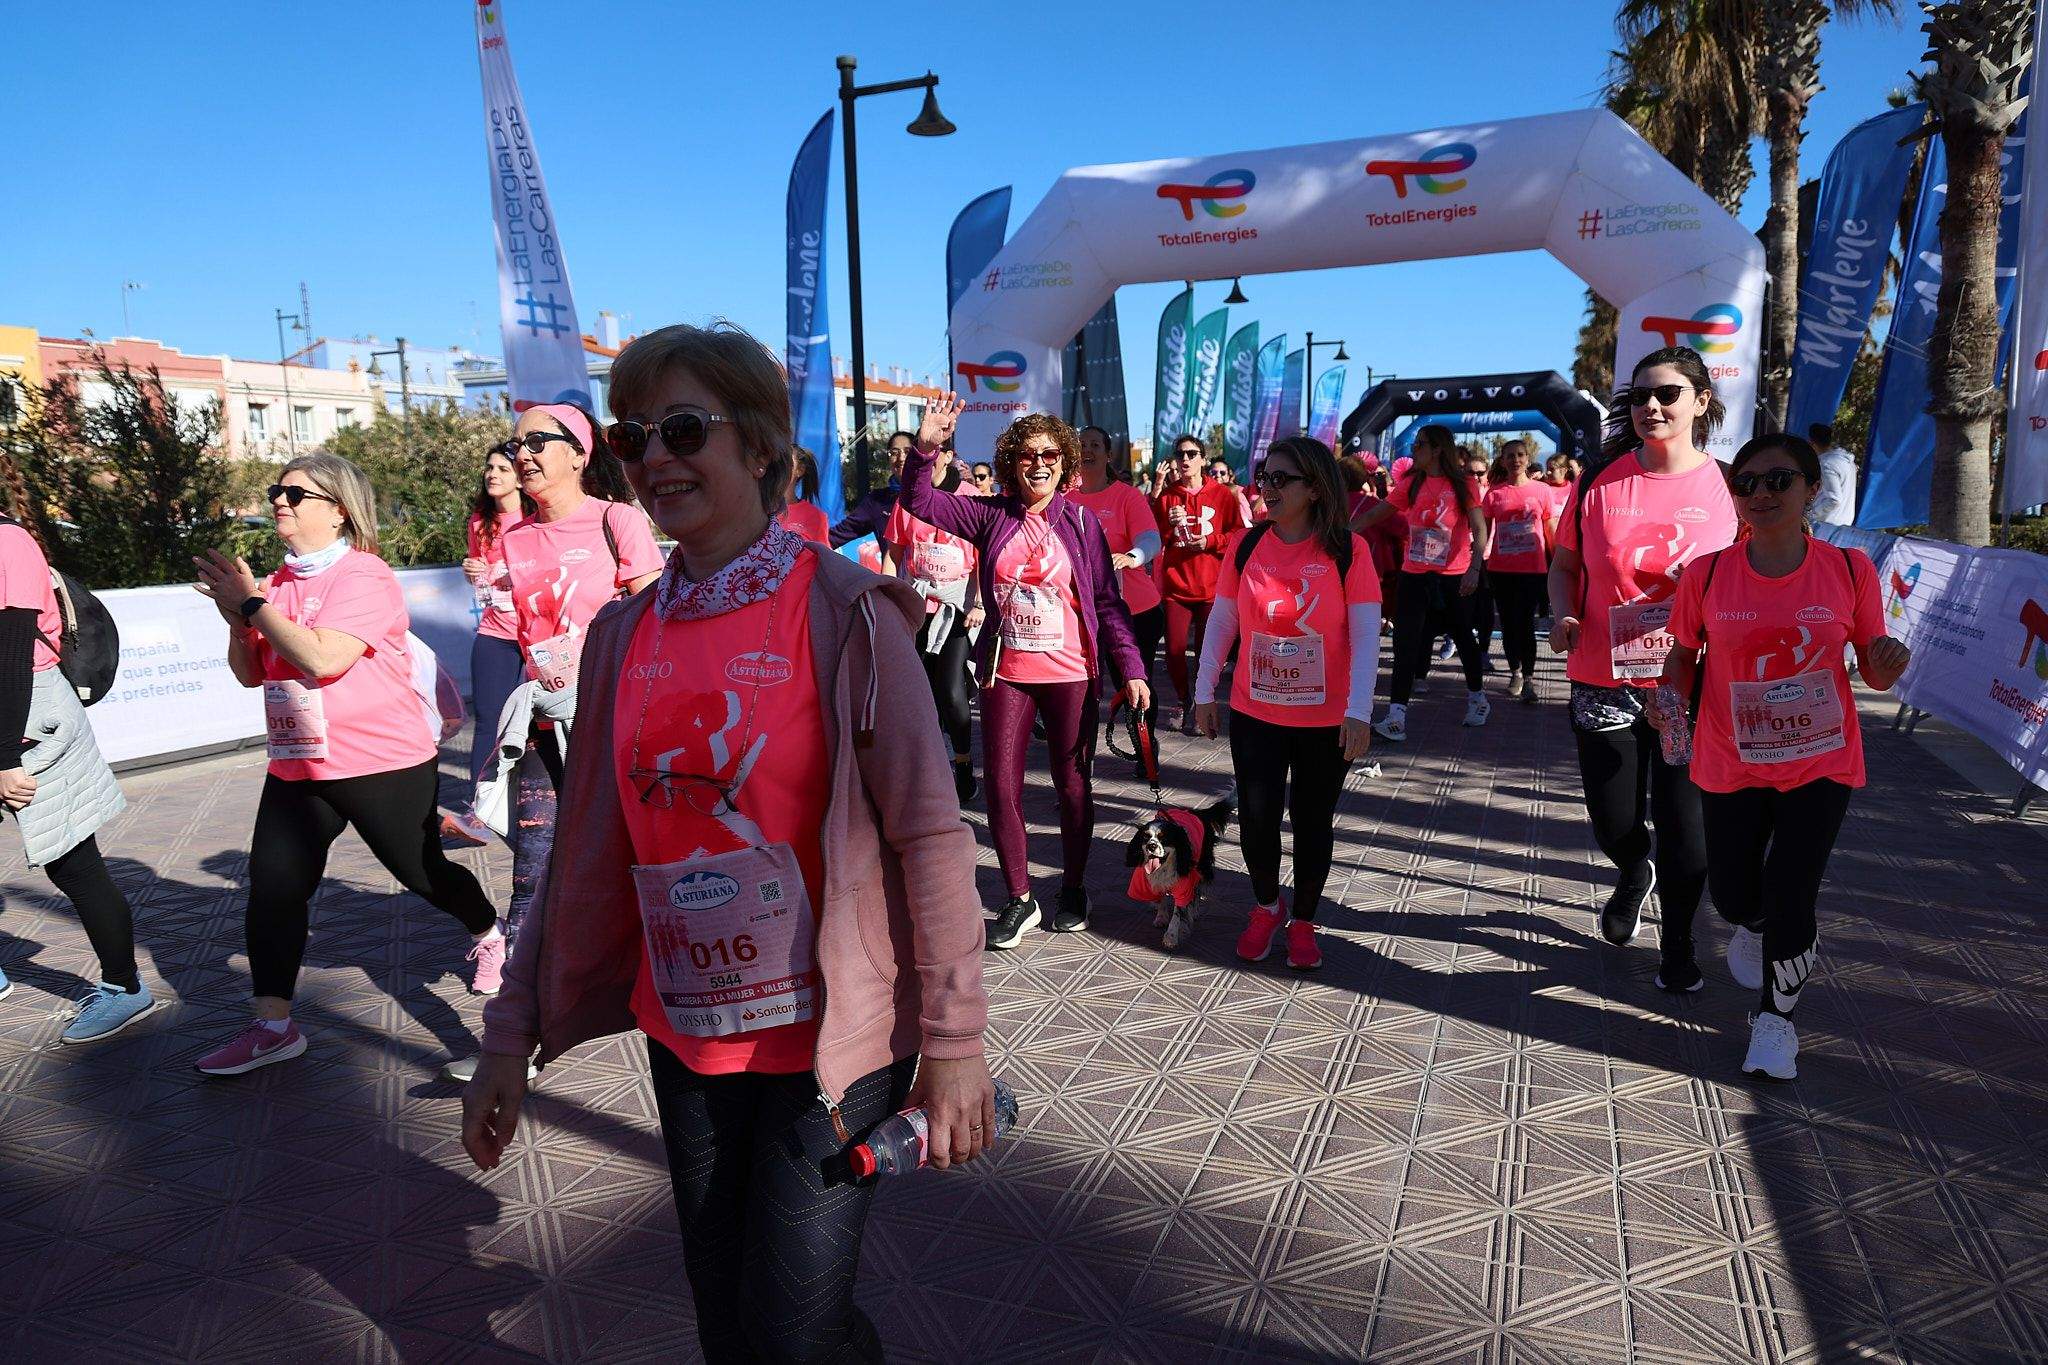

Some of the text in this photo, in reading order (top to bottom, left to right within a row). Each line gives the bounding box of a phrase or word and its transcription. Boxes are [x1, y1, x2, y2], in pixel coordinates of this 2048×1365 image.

[504, 106, 562, 286] LasCarreras
[1366, 204, 1477, 227] TotalEnergies
[1158, 227, 1258, 247] TotalEnergies
[1799, 218, 1877, 368] Marlene
[1407, 385, 1526, 401] VOLVO
[928, 564, 946, 573] 016
[1016, 614, 1041, 626] 016
[1716, 611, 1757, 621] OYSHO
[1272, 668, 1300, 679] 016
[122, 681, 204, 702] preferidas
[547, 676, 565, 692] 16
[1771, 713, 1812, 731] 016
[1751, 751, 1784, 759] OYSHO
[674, 884, 735, 904] ASTURIANA
[690, 934, 758, 970] 016
[710, 973, 743, 989] 5944
[703, 996, 714, 1004] DE
[715, 995, 725, 1003] LA
[727, 990, 755, 1001] MUJER
[761, 978, 804, 994] VALENCIA
[679, 1000, 813, 1028] OYSHO Santander
